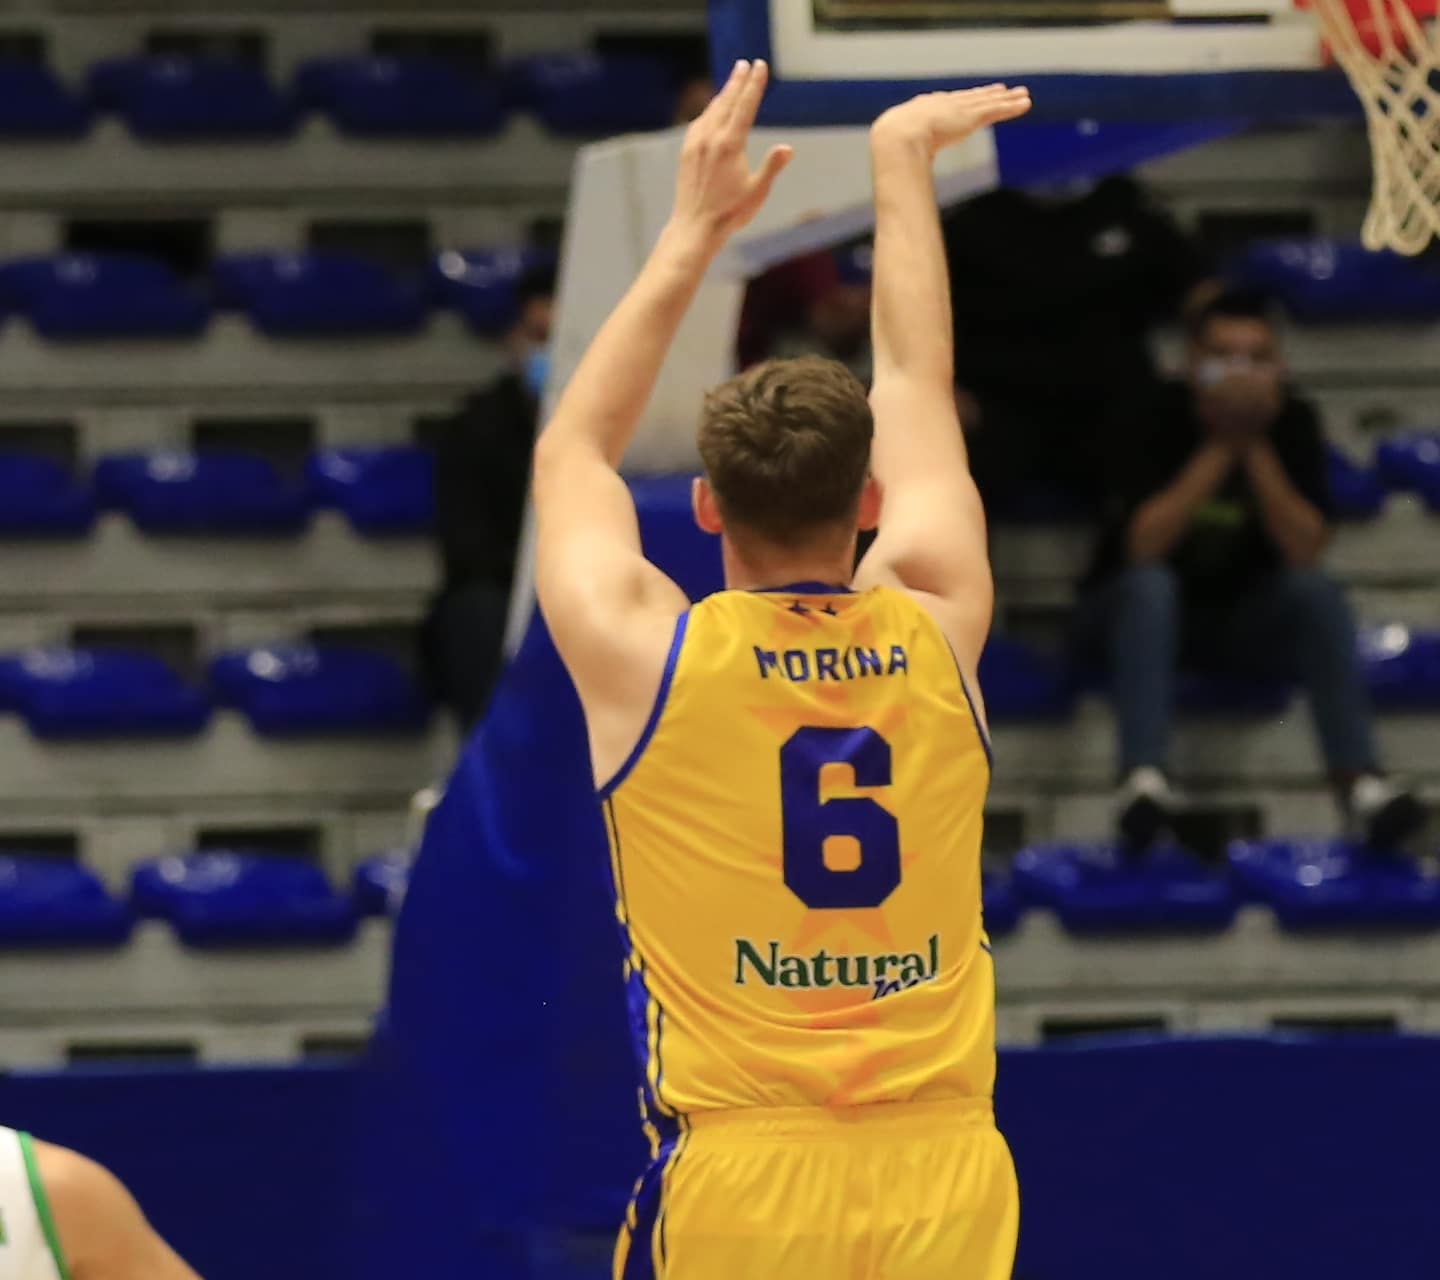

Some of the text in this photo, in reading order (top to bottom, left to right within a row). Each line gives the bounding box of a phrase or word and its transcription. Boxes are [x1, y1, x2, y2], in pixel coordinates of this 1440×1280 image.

[753, 645, 908, 682] MORINA
[779, 725, 902, 909] 6
[734, 933, 939, 988] Natural
